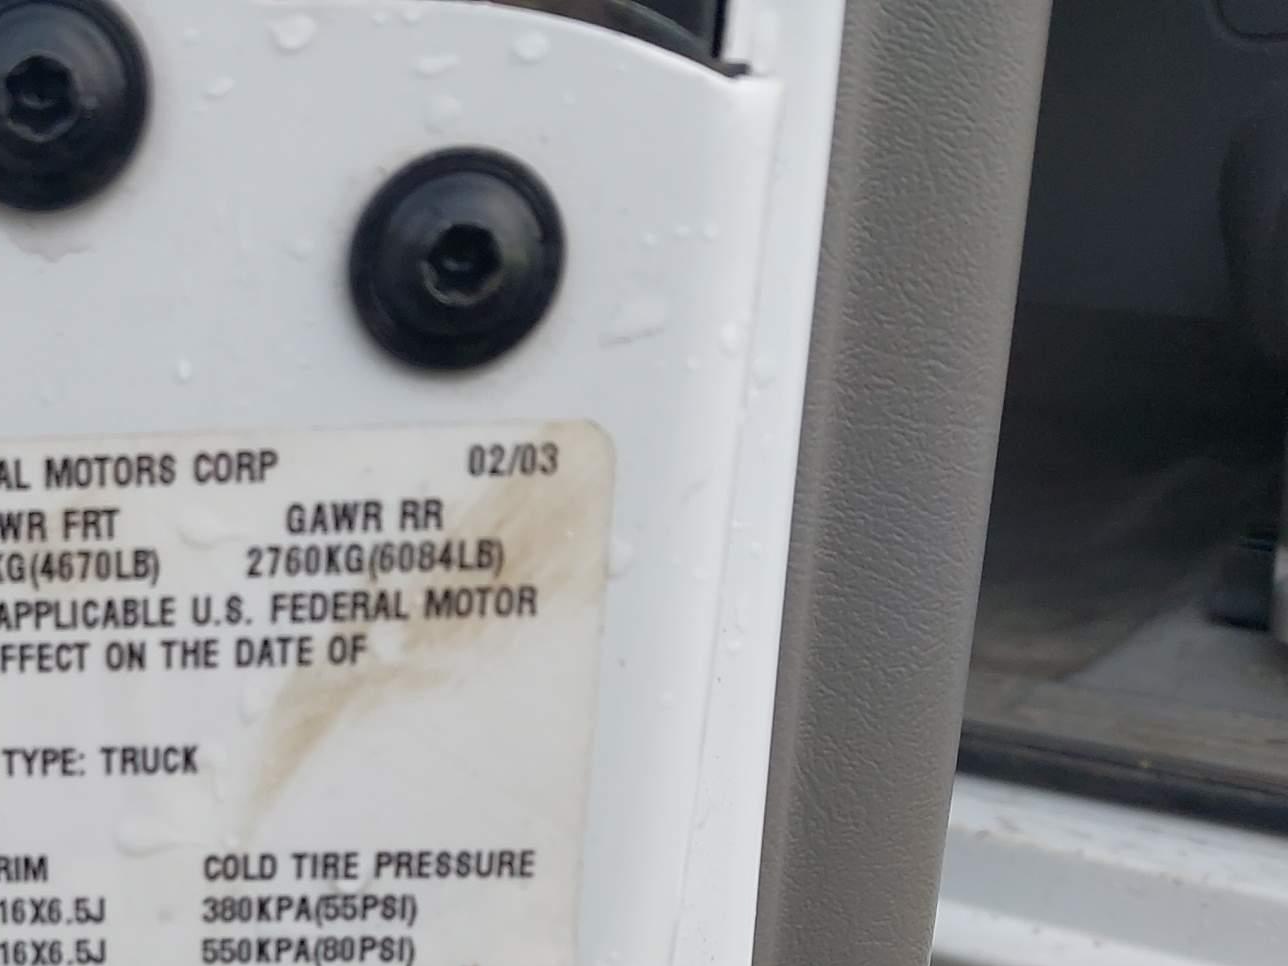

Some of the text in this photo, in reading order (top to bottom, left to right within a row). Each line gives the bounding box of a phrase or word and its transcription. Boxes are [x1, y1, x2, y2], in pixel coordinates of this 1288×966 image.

[44, 453, 176, 489] MOTORS
[193, 449, 279, 484] CORP
[467, 442, 559, 479] 02/03
[63, 507, 120, 541] FRT
[285, 498, 444, 537] GAWR RR
[246, 539, 505, 583] 2760KG(6084LB)
[191, 594, 253, 627] U.S.
[270, 589, 410, 625] FEDERAL
[424, 586, 539, 621] MOTOR
[105, 640, 147, 672] ON
[162, 638, 220, 670] THE
[235, 635, 314, 668] DATE
[327, 633, 368, 666] OF
[2, 745, 199, 778] TYPE: TRUCK
[203, 850, 535, 881] COLD TIRE PRESSURE
[201, 894, 418, 928] 380KPA(55PSI)
